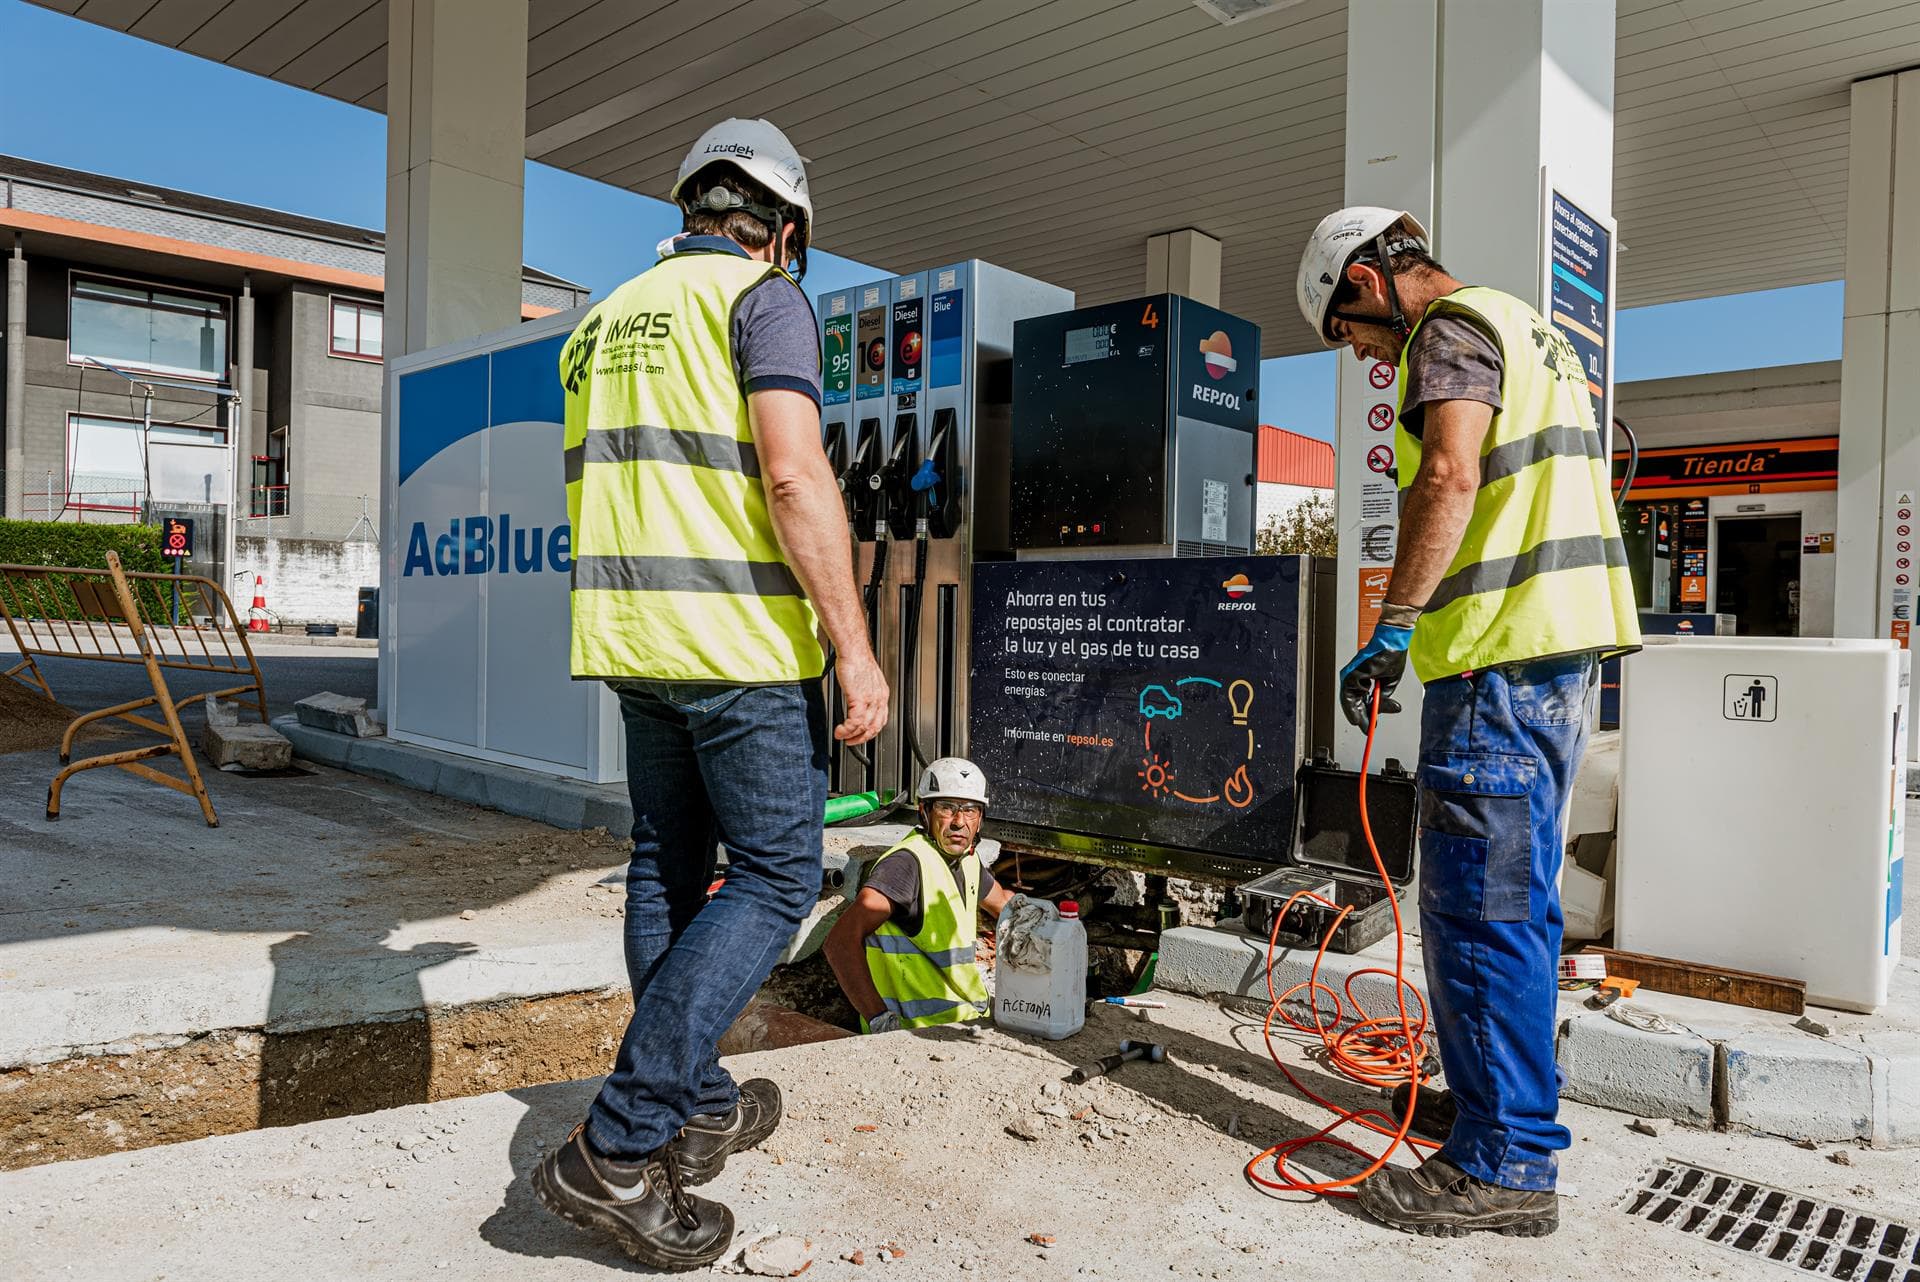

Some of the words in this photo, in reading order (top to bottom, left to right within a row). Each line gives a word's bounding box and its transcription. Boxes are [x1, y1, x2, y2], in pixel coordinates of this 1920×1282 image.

[859, 315, 880, 330] Diesel
[895, 307, 918, 322] Diesel
[1141, 303, 1159, 329] 4
[1590, 304, 1597, 325] 5
[604, 312, 673, 344] IMAS
[825, 322, 851, 336] efitec
[1110, 323, 1117, 334] €
[1109, 339, 1115, 347] L
[832, 352, 850, 373] 95
[1588, 352, 1598, 376] 10
[1192, 384, 1241, 411] REPSOL
[1640, 512, 1649, 524] 2
[403, 513, 572, 577] AdBlue
[1006, 590, 1054, 606] Ahorra
[1058, 594, 1076, 607] en
[1081, 591, 1106, 606] tus
[1217, 602, 1257, 611] REPSOL
[1005, 614, 1083, 635] repostajes
[1087, 614, 1102, 631] al
[1107, 616, 1185, 633] contratar
[1005, 636, 1018, 652] la
[1023, 636, 1044, 653] luz
[1048, 641, 1057, 658] y
[1061, 638, 1076, 655] el
[1080, 642, 1108, 659] gas
[1113, 640, 1132, 657] de
[1137, 641, 1154, 658] tu
[1160, 645, 1200, 659] casa
[1005, 668, 1026, 680] Esto
[1028, 671, 1039, 680] es
[1041, 671, 1085, 683] conectar
[1004, 685, 1048, 698] energías.
[1004, 726, 1050, 742] Infórmate
[1052, 734, 1065, 742] en
[1067, 733, 1114, 747] repsol.es
[1003, 998, 1050, 1020] ACETONA
